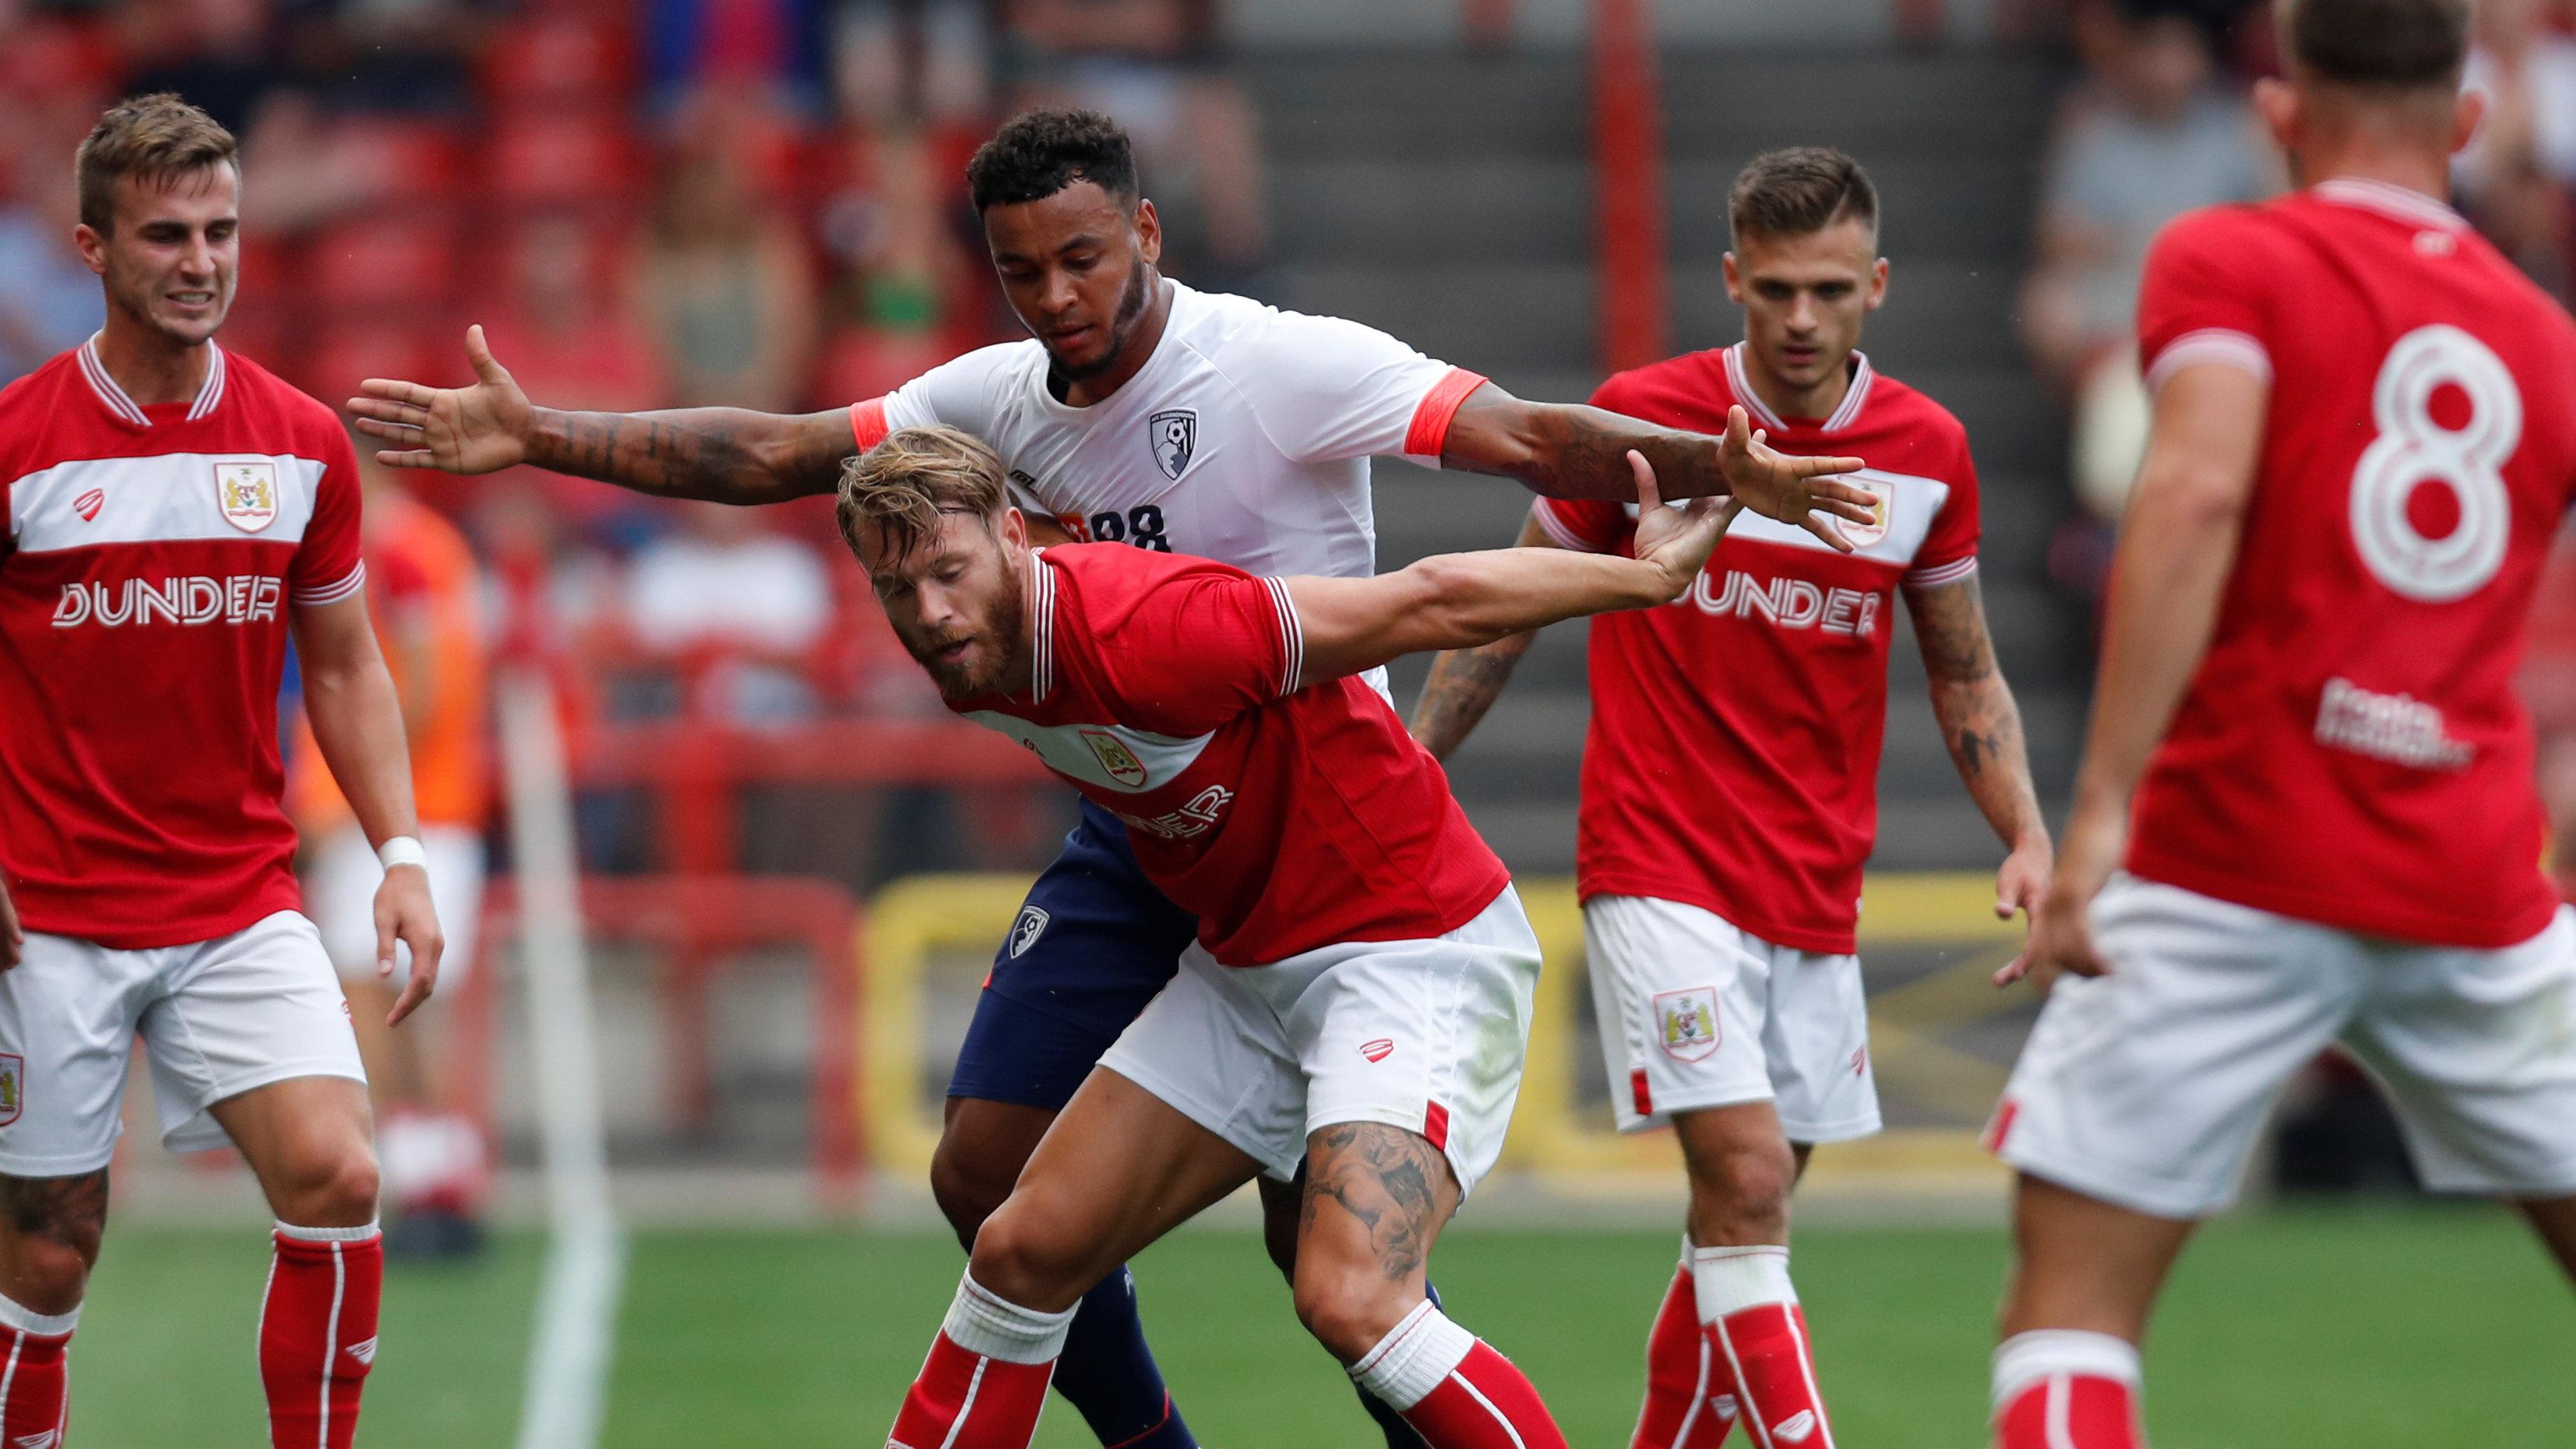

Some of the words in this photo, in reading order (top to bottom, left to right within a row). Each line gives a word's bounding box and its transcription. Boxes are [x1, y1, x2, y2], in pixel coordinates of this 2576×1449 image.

[2349, 323, 2523, 602] 8
[51, 574, 281, 628] DUNDER
[1672, 566, 1882, 637] UNDER
